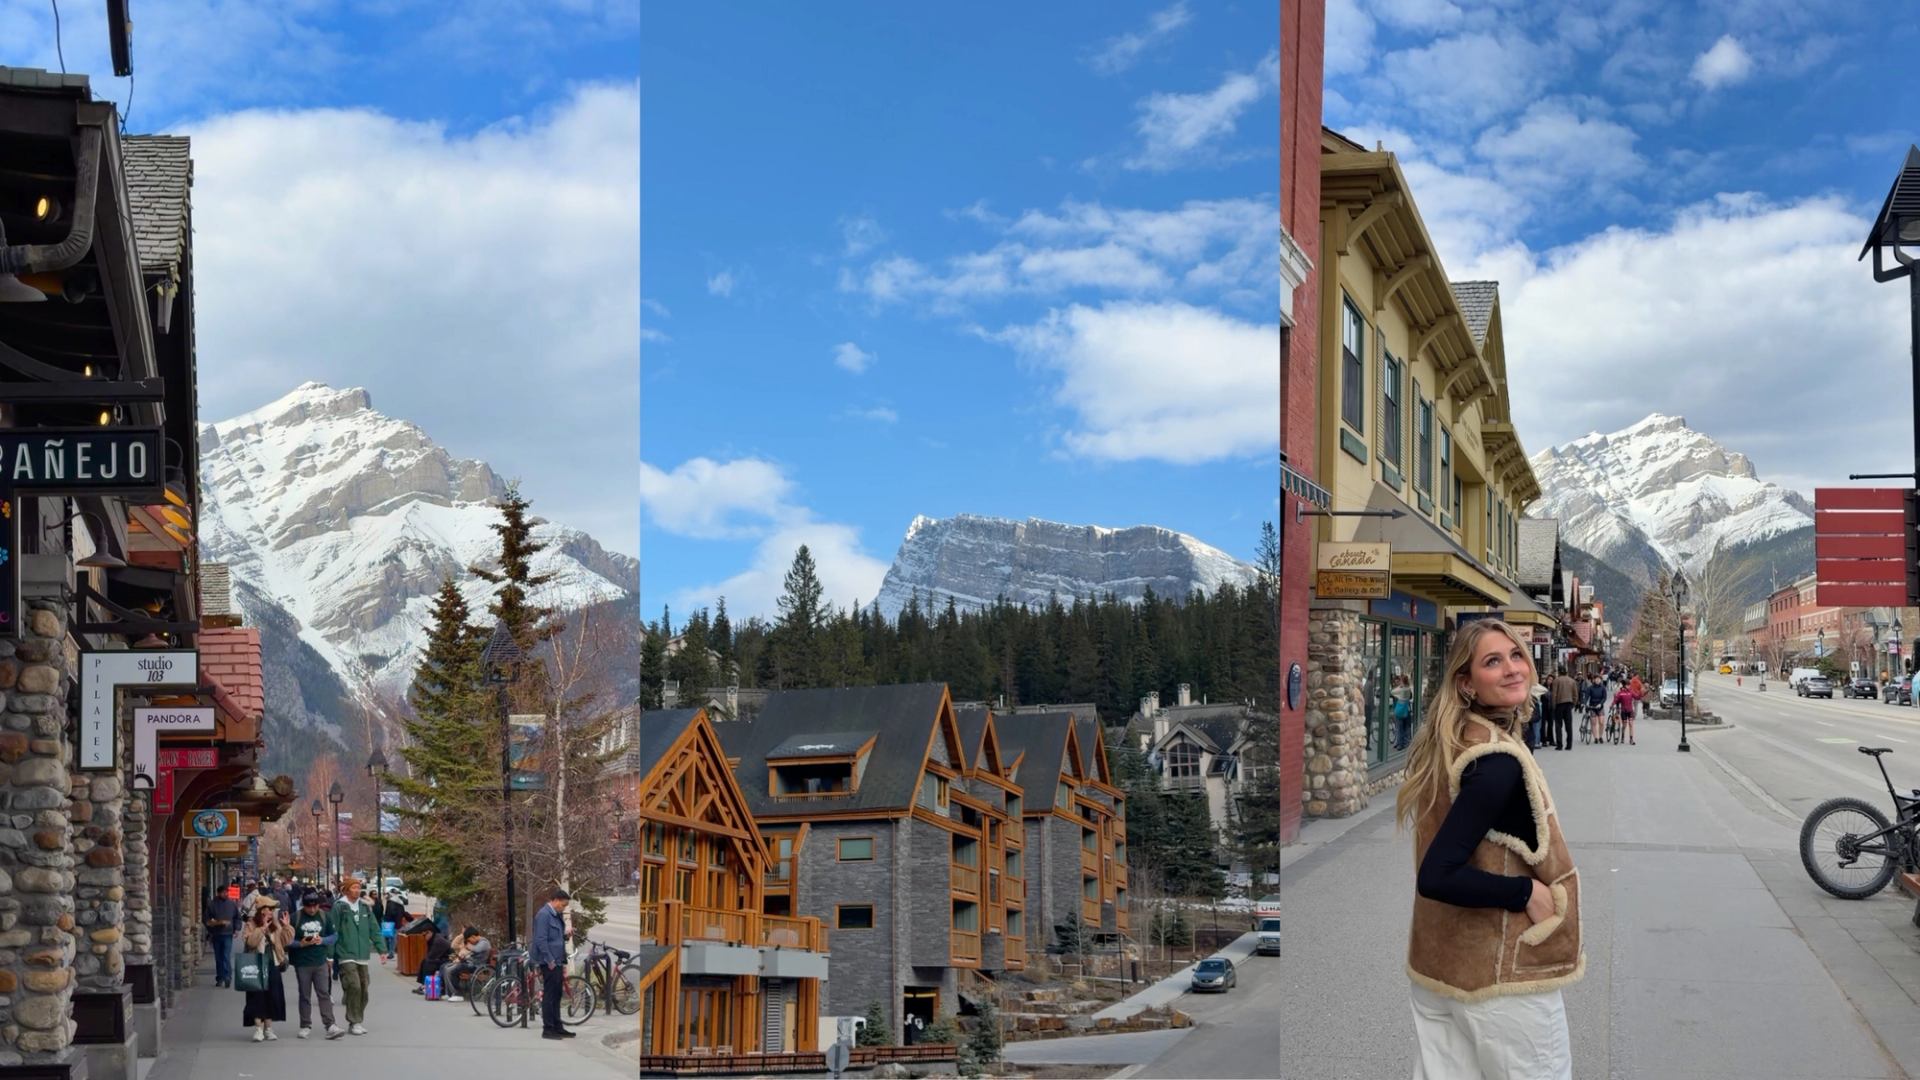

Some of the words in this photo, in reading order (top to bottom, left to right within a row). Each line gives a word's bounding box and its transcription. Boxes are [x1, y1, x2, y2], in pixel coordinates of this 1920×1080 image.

[13, 438, 147, 480] AÑEJO
[1330, 555, 1376, 567] Canada
[137, 656, 173, 671] studio
[147, 671, 164, 682] 103
[93, 659, 101, 761] PILATES
[147, 714, 201, 724] PANDORA
